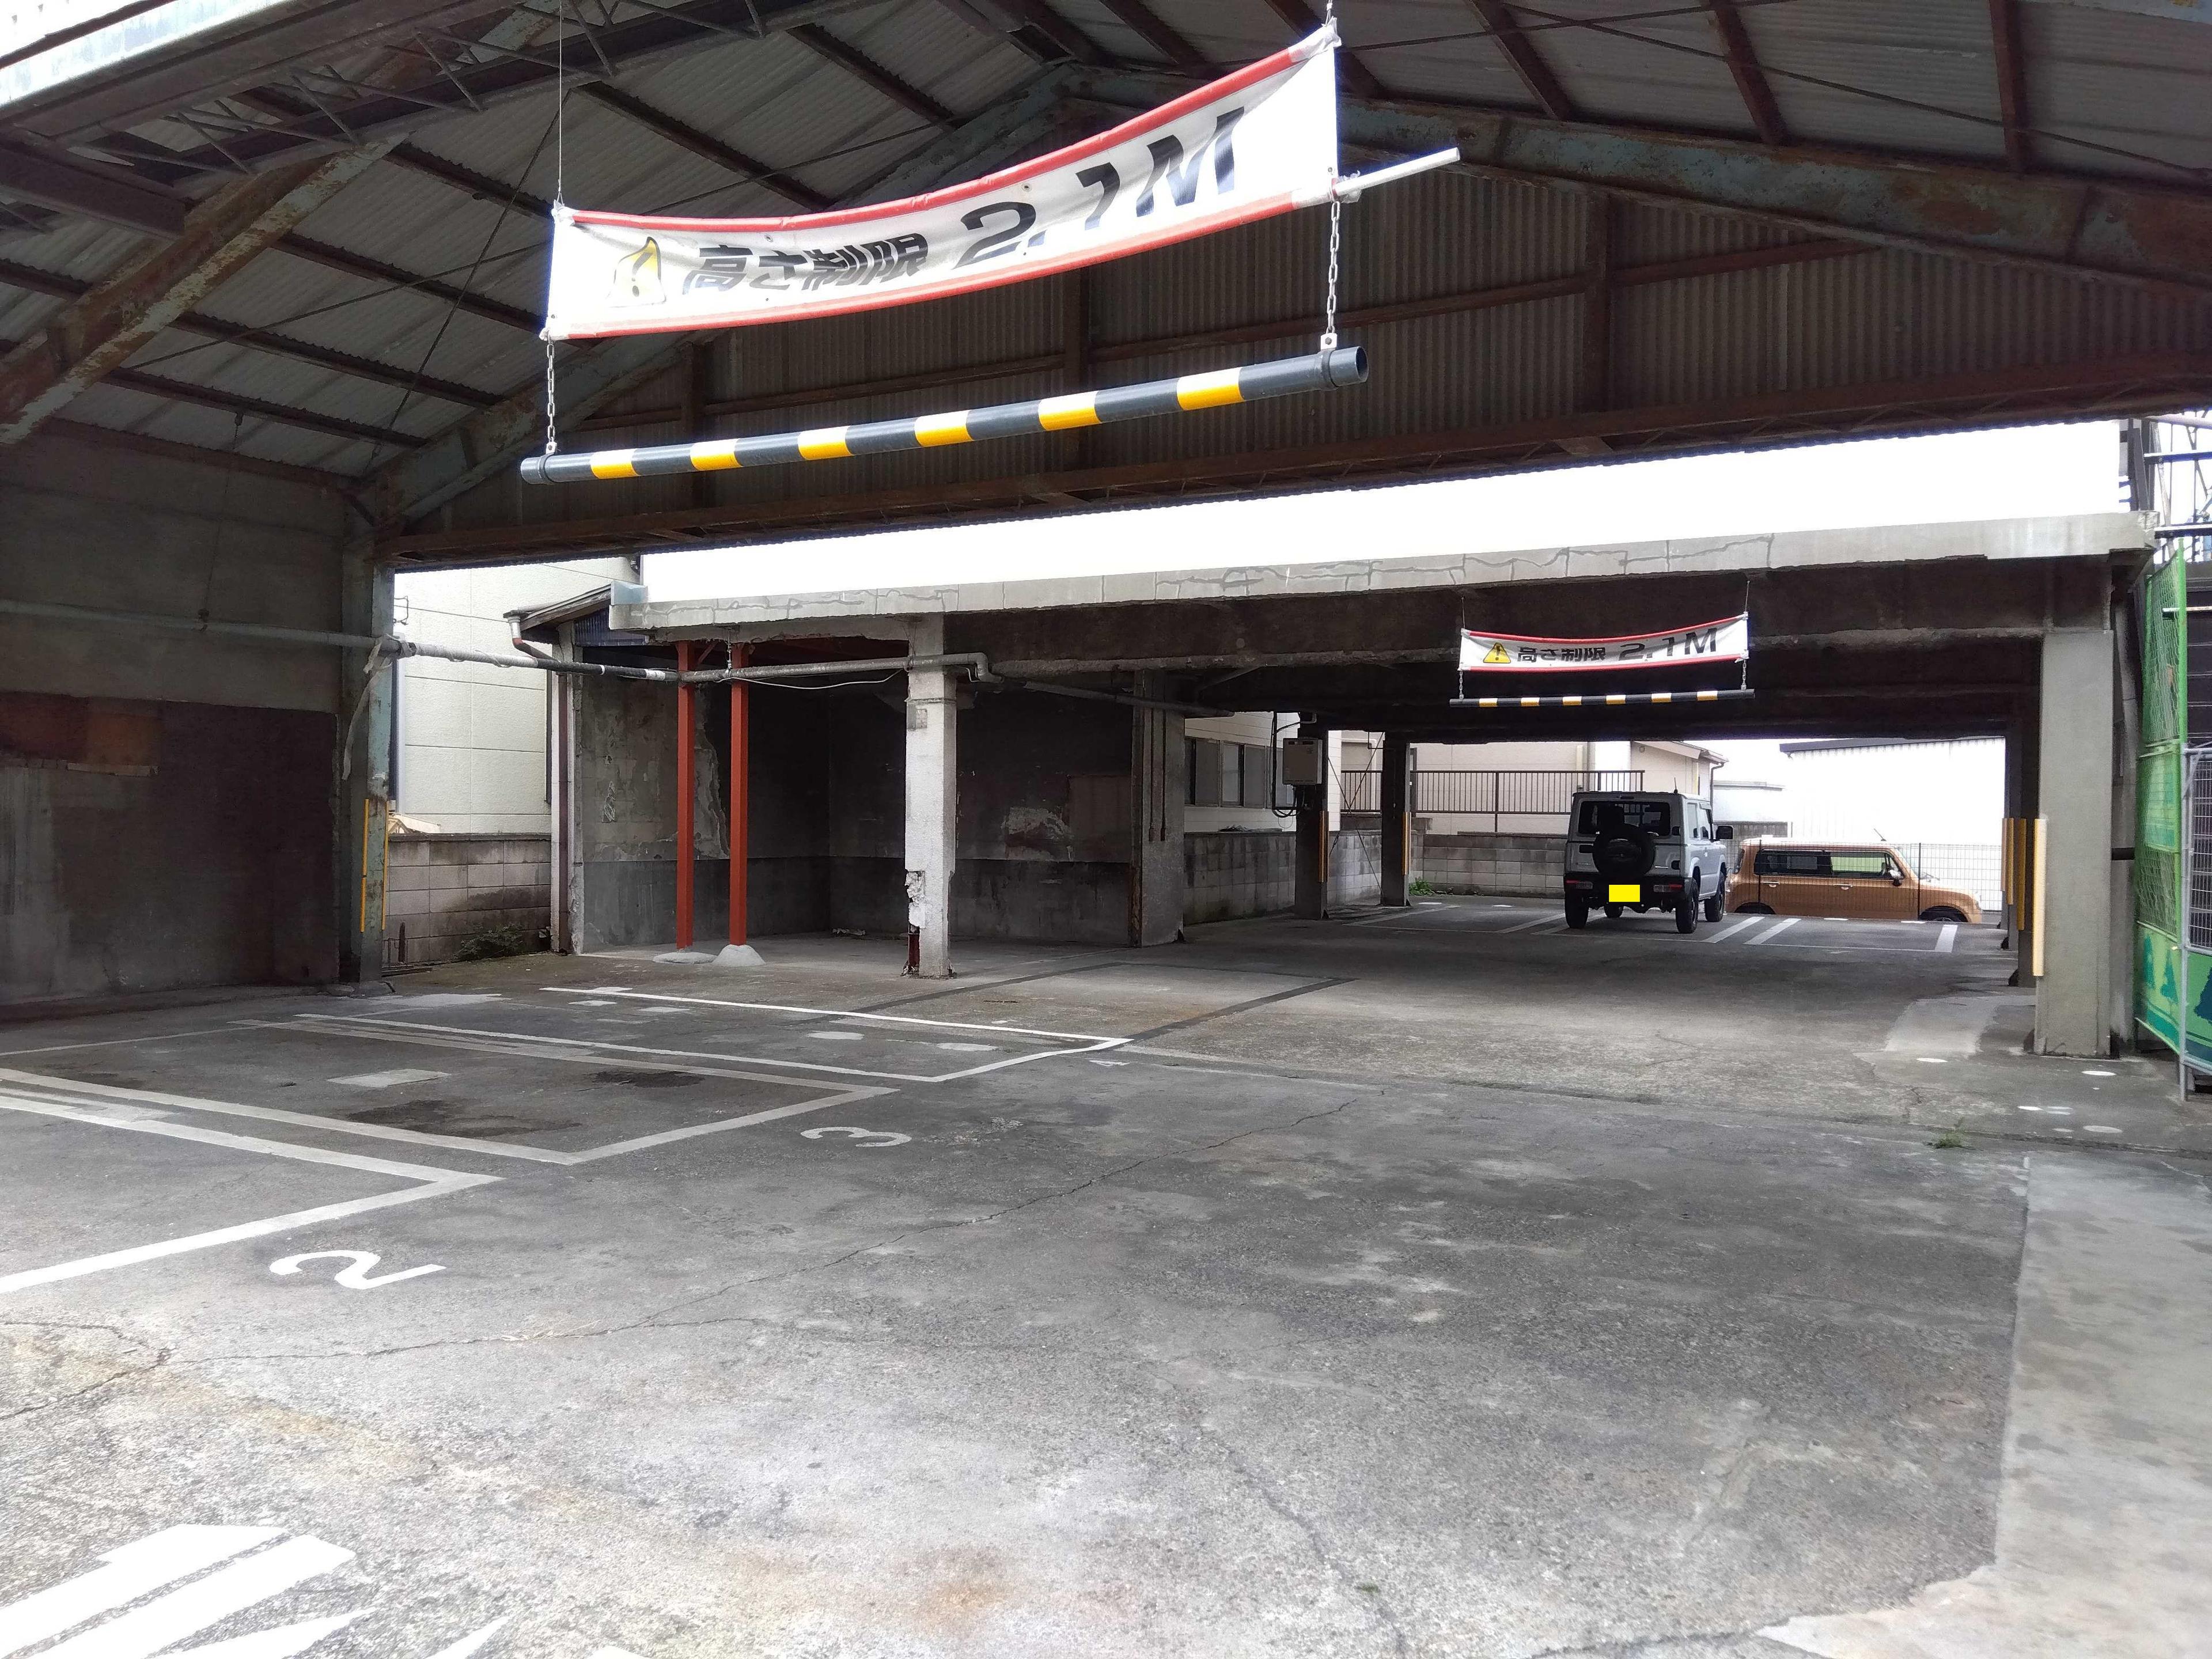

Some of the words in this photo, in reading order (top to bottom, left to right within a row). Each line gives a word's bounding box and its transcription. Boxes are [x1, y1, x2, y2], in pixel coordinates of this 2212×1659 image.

[681, 232, 929, 296] 高さ制限
[952, 105, 1245, 271] 2.1M
[1517, 646, 1606, 663] 高さ制限
[1618, 627, 1718, 662] 2.1M
[800, 1126, 912, 1147] 3
[268, 1249, 447, 1290] 2
